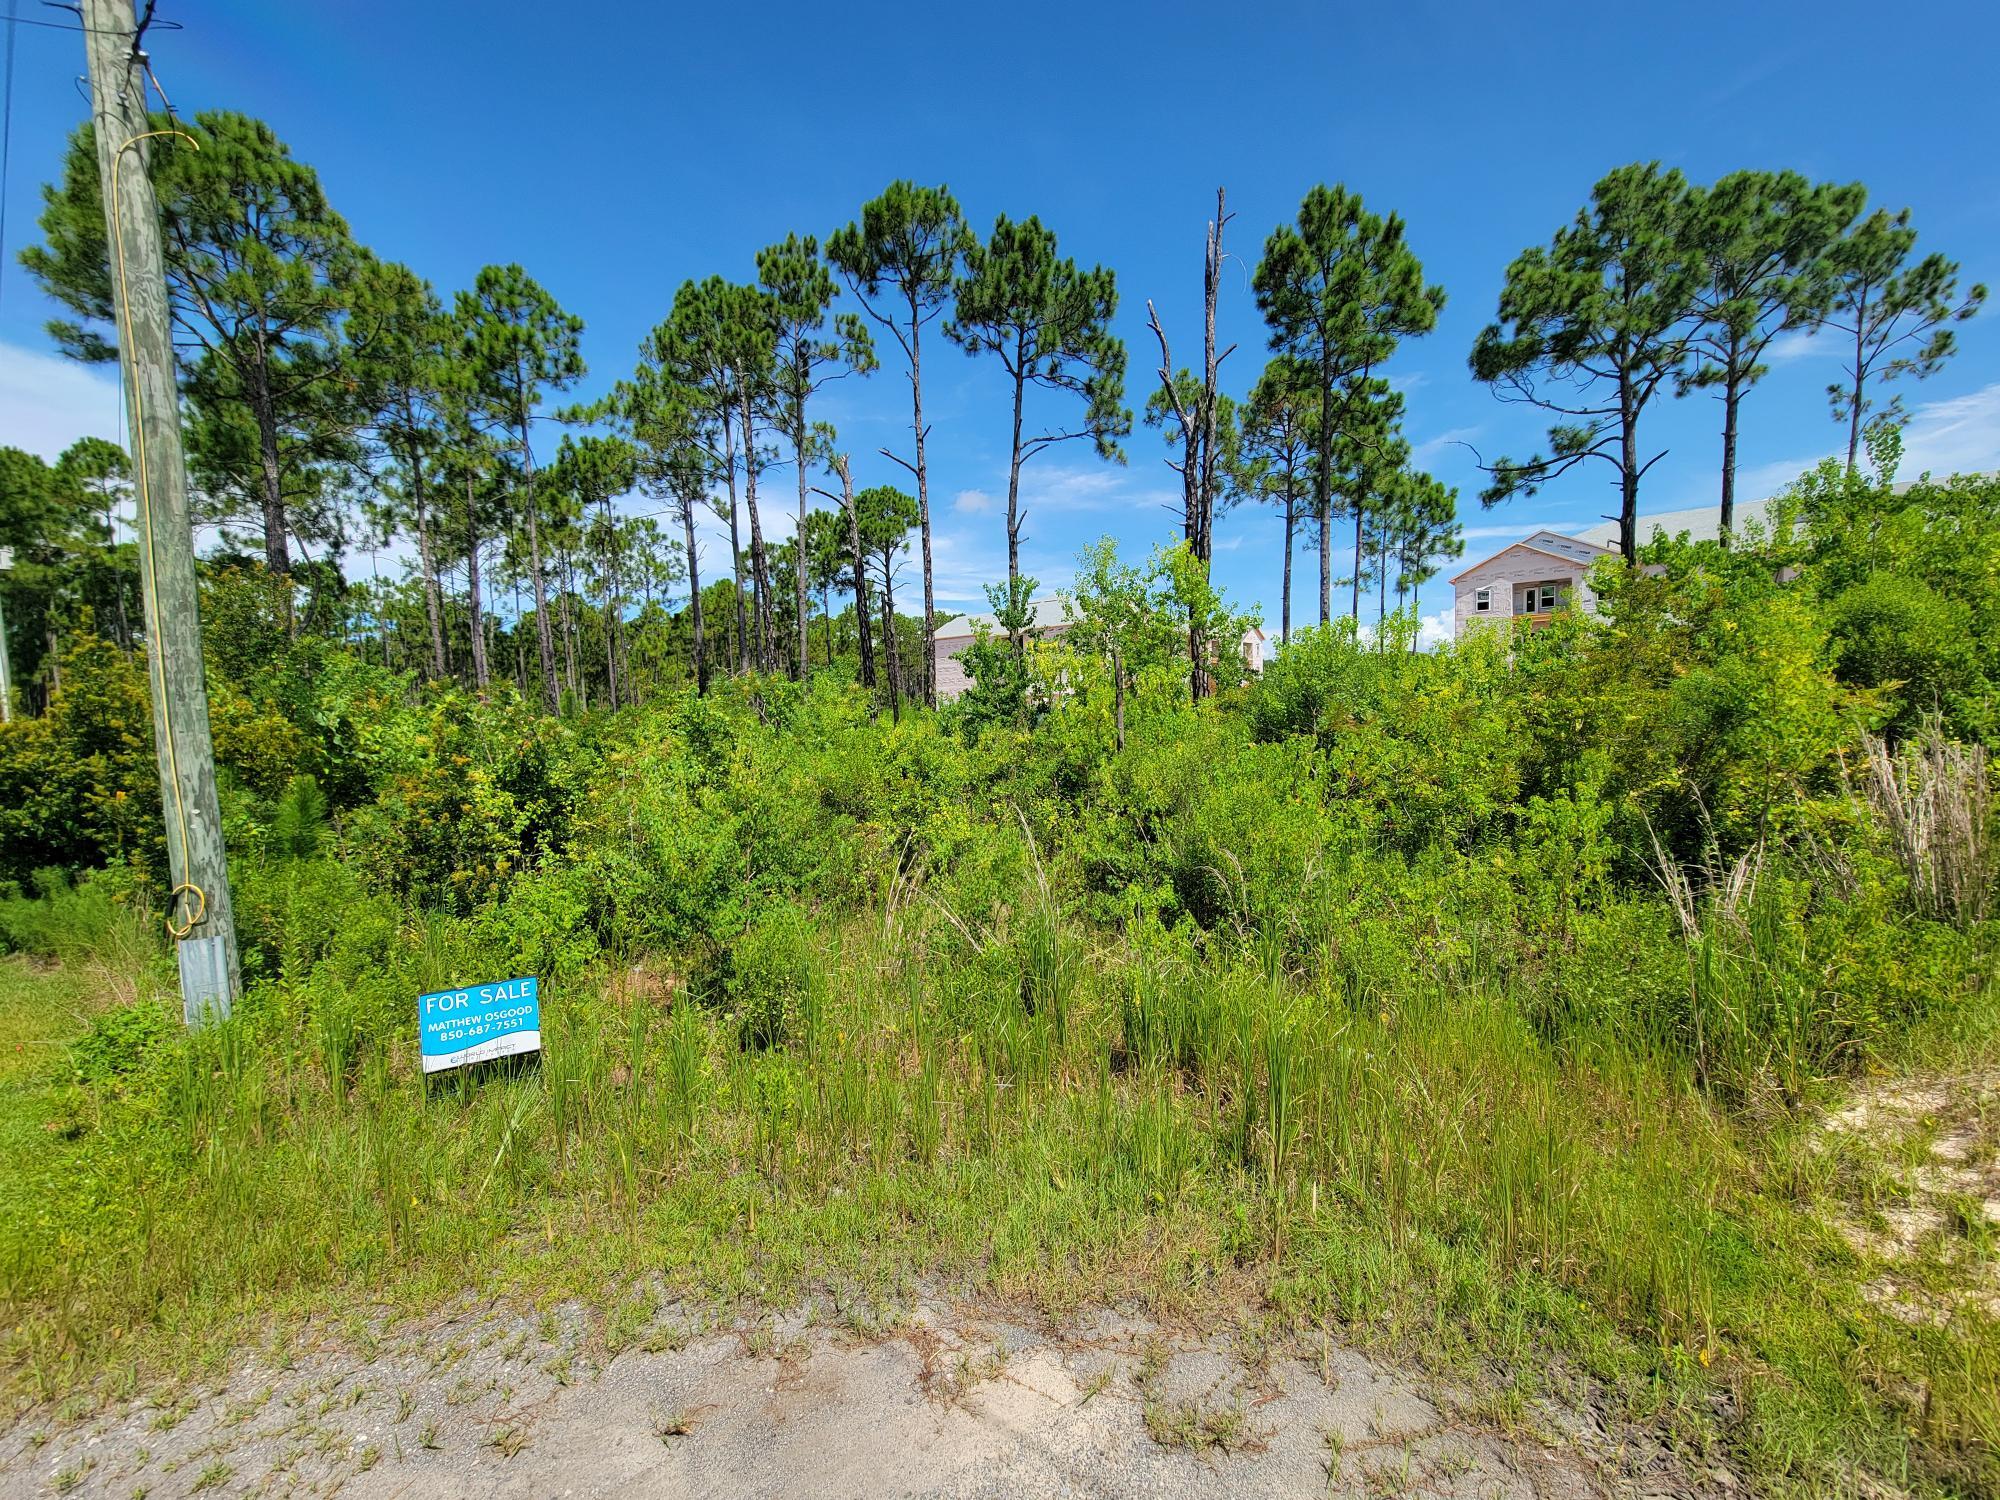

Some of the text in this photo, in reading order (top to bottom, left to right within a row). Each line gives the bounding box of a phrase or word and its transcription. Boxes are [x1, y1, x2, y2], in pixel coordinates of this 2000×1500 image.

[426, 981, 532, 1014] FOR SALE
[428, 1005, 533, 1033] MATTHEW OSGOOD
[441, 1018, 523, 1042] 850-687-7551
